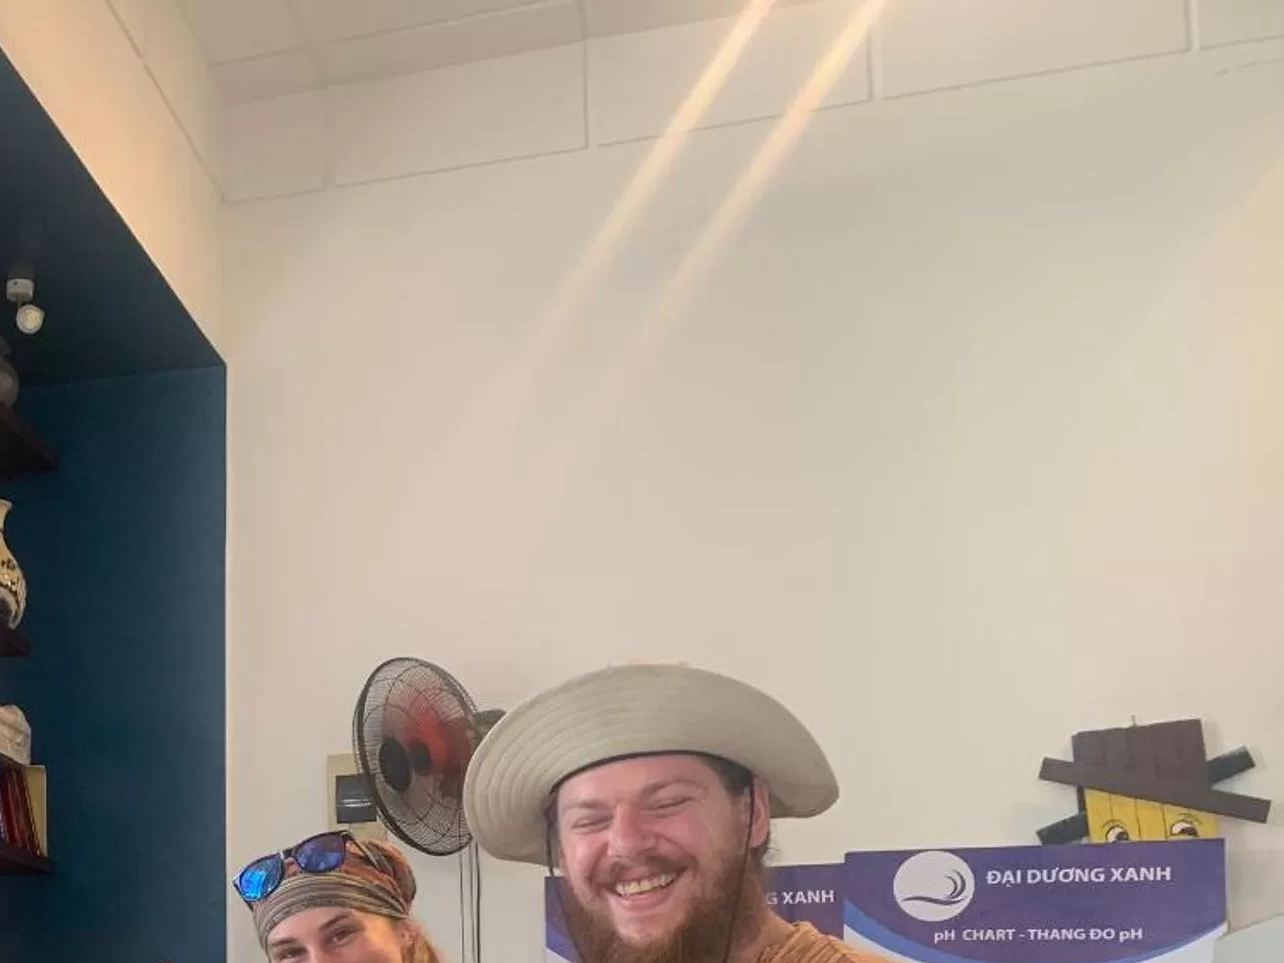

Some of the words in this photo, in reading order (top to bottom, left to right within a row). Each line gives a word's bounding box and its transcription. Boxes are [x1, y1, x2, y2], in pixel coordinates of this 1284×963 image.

[986, 869, 1022, 887] ĐẠI
[1027, 867, 1105, 884] DƯƠNG
[1110, 867, 1172, 882] XANH
[782, 890, 835, 905] XANH
[934, 927, 956, 944] pH
[962, 927, 1017, 942] CHART
[1028, 927, 1087, 941] THANG
[1090, 927, 1115, 941] ĐO
[1119, 927, 1143, 944] pH
